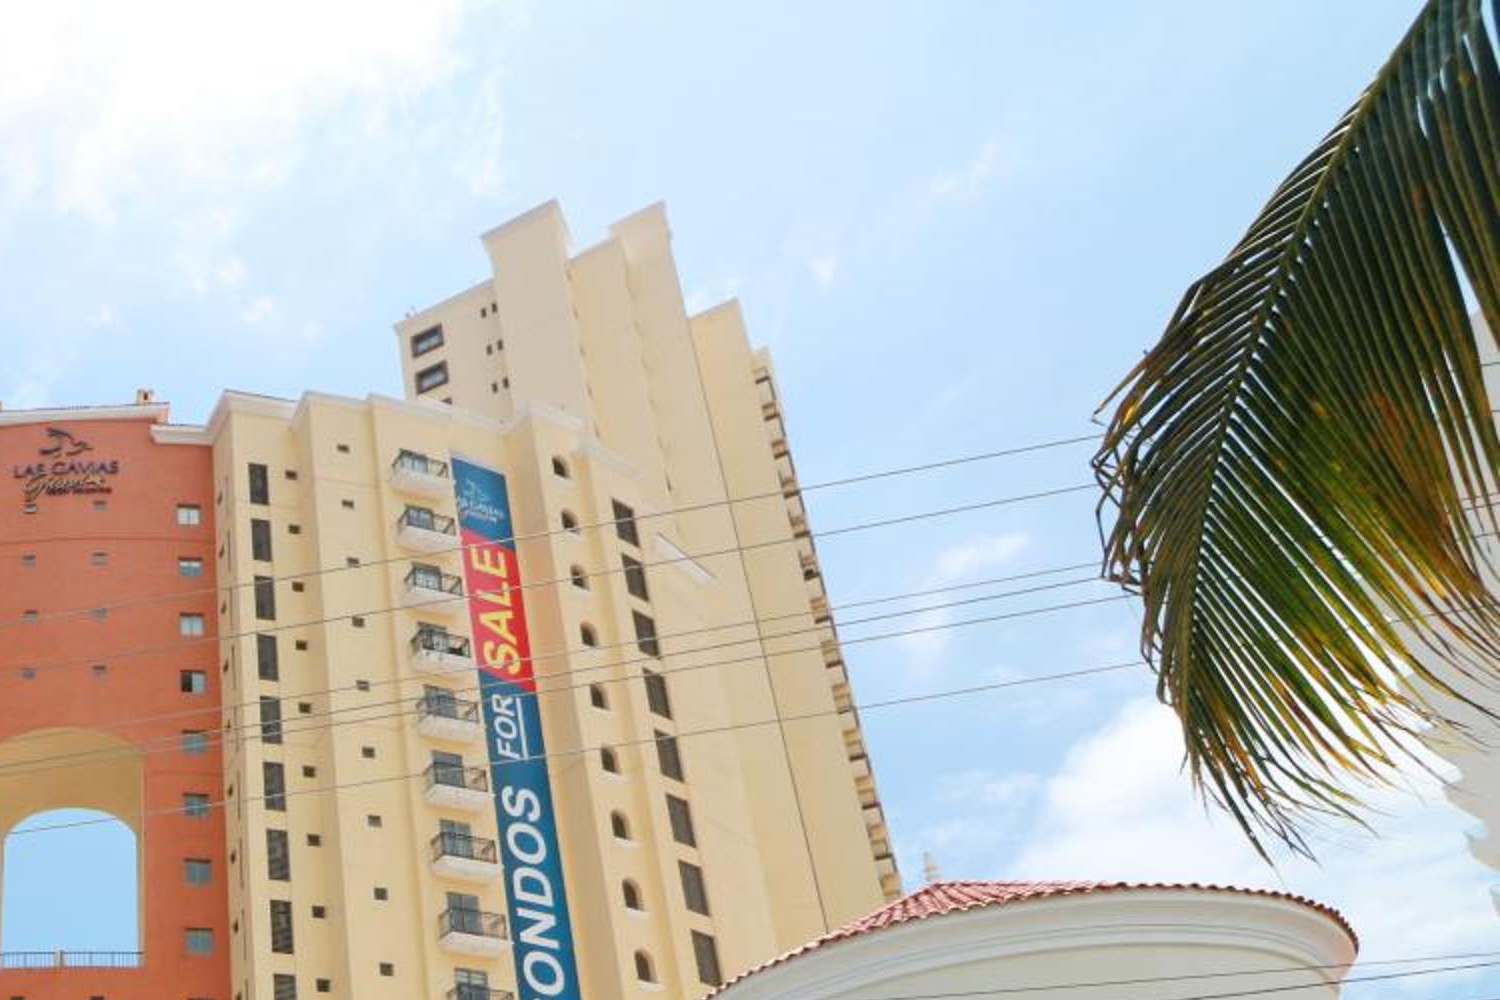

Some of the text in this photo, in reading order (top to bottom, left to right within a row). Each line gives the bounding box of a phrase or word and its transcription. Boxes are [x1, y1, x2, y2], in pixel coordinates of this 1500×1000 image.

[13, 460, 120, 478] LAS GAVIAS
[471, 543, 522, 676] SALE
[491, 693, 521, 761] FOR
